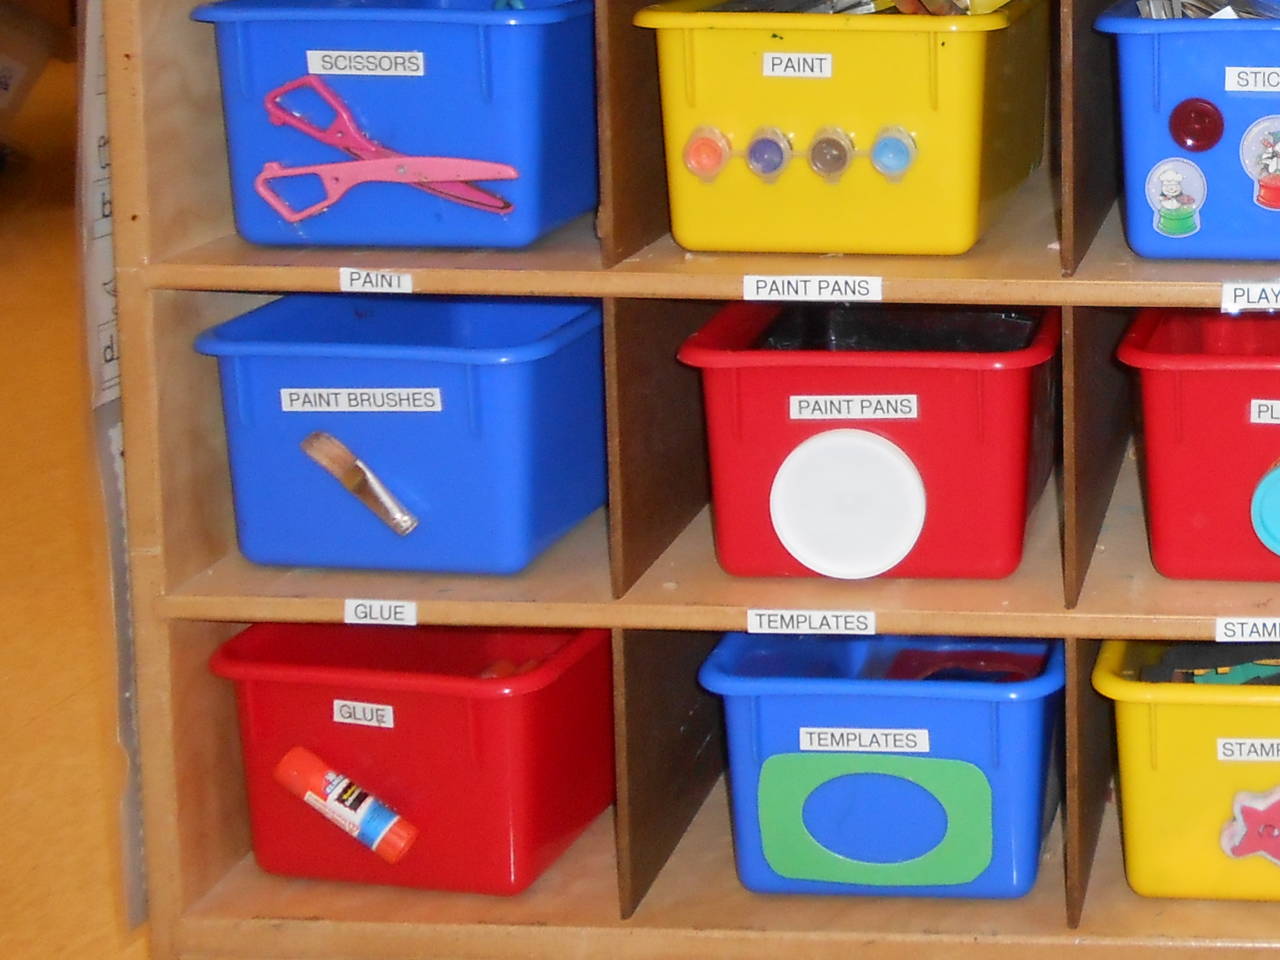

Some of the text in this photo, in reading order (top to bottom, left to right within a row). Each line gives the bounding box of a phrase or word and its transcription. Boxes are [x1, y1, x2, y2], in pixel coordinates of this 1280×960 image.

[321, 55, 420, 72] SCISSORS
[771, 57, 826, 72] PAINT
[349, 272, 402, 288] PAINT
[756, 280, 870, 296] PAINT PANS
[289, 392, 436, 408] PAINT BRUSHES
[798, 399, 912, 415] PAINT PANS
[354, 604, 405, 620] GLUE
[755, 613, 869, 630] TEMPLATES
[339, 704, 385, 723] GLUE
[806, 732, 918, 748] TEMPLATES
